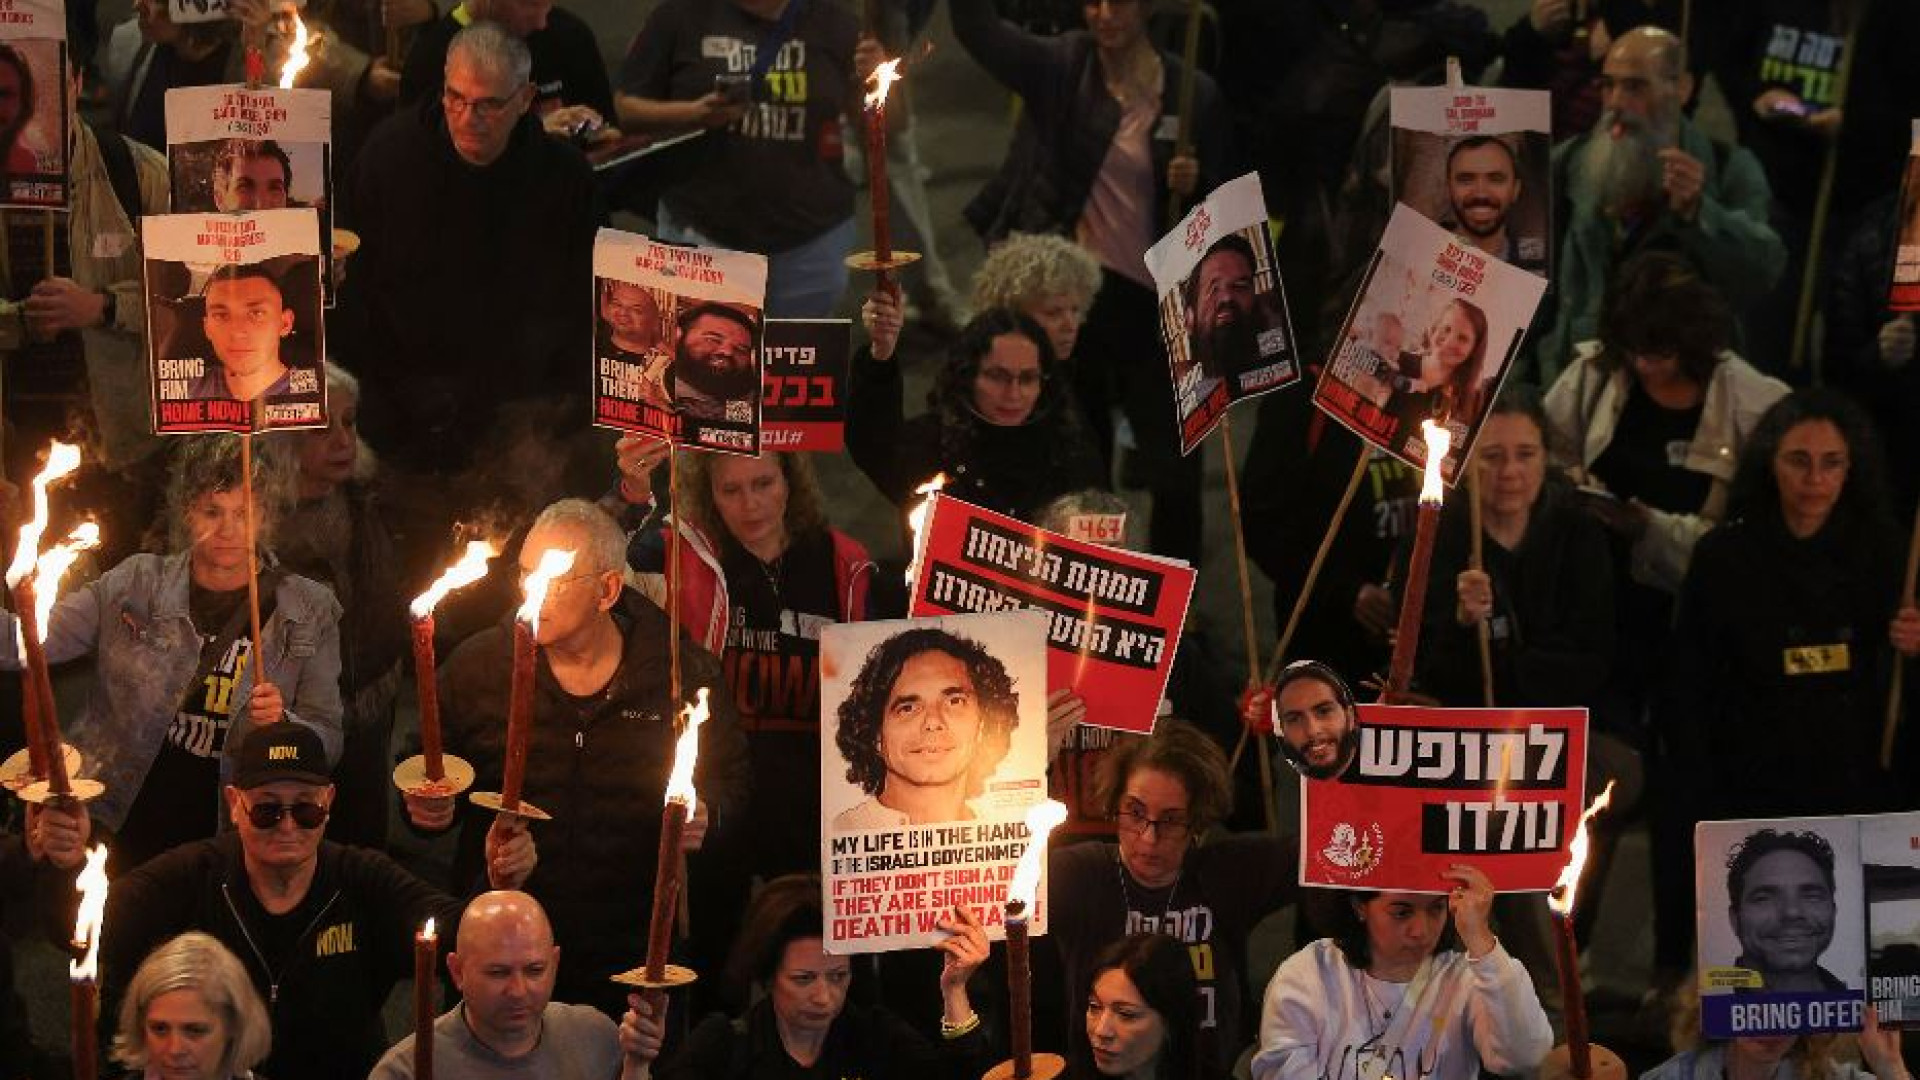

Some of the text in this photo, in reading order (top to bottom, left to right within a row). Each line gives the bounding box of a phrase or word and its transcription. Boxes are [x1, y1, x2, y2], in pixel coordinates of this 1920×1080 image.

[157, 358, 205, 380] BRING
[600, 357, 645, 384] BRING
[765, 347, 816, 365] פדיו
[601, 376, 640, 402] THEM
[161, 401, 205, 423] HOME
[207, 400, 251, 425] NOW!
[600, 398, 684, 436] HOME NOW!
[1078, 516, 1120, 540] 467
[1029, 604, 1112, 654] החטו
[1113, 629, 1166, 664] היא
[268, 746, 300, 760] NOW.
[1359, 723, 1565, 782] לחופש
[1446, 796, 1559, 851] נולדו
[832, 821, 1032, 856] MY LIFE IS IN THE HAND
[866, 851, 929, 873] ISRAELI
[931, 842, 1030, 867] GOVERNMEN
[833, 879, 847, 896] IF
[850, 875, 892, 895] THEY
[894, 871, 941, 891] DON'T
[943, 867, 981, 886] SIGN
[983, 867, 996, 884] A
[833, 884, 1008, 917] THEY ARE SIGNING
[316, 921, 357, 958] NOW.
[832, 912, 911, 941] DEATH
[1872, 974, 1920, 1000] BRING
[1731, 1002, 1802, 1032] BRING
